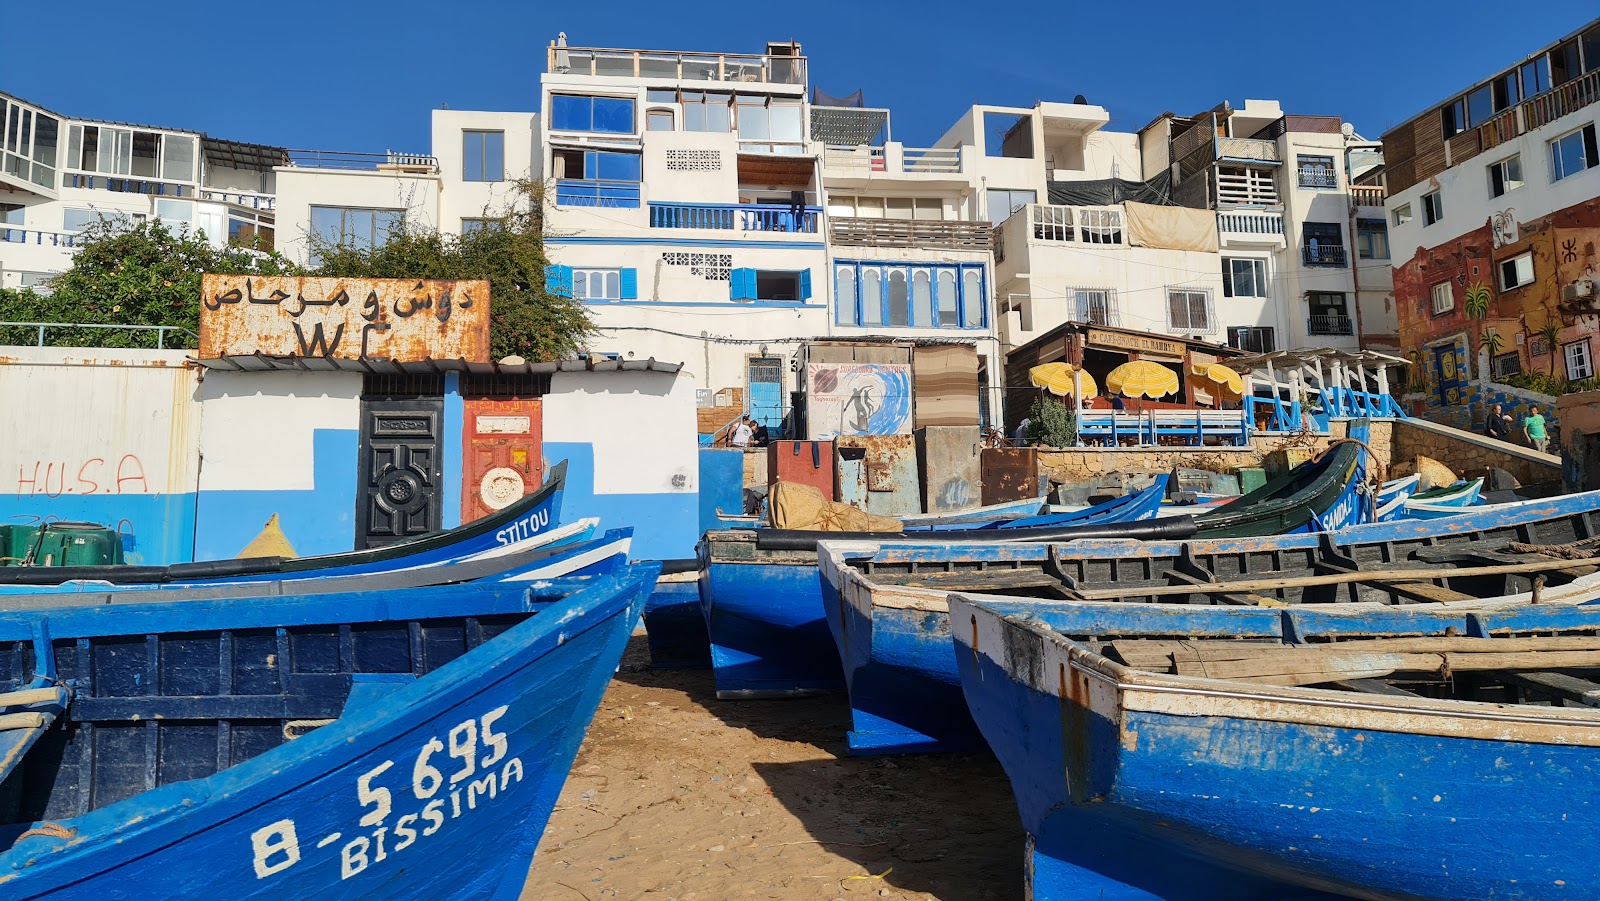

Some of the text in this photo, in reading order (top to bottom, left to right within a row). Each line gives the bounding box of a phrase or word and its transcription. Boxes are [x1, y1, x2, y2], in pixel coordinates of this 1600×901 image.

[203, 277, 350, 318] مرحاض
[360, 289, 380, 321] و
[496, 508, 549, 546] STITOU
